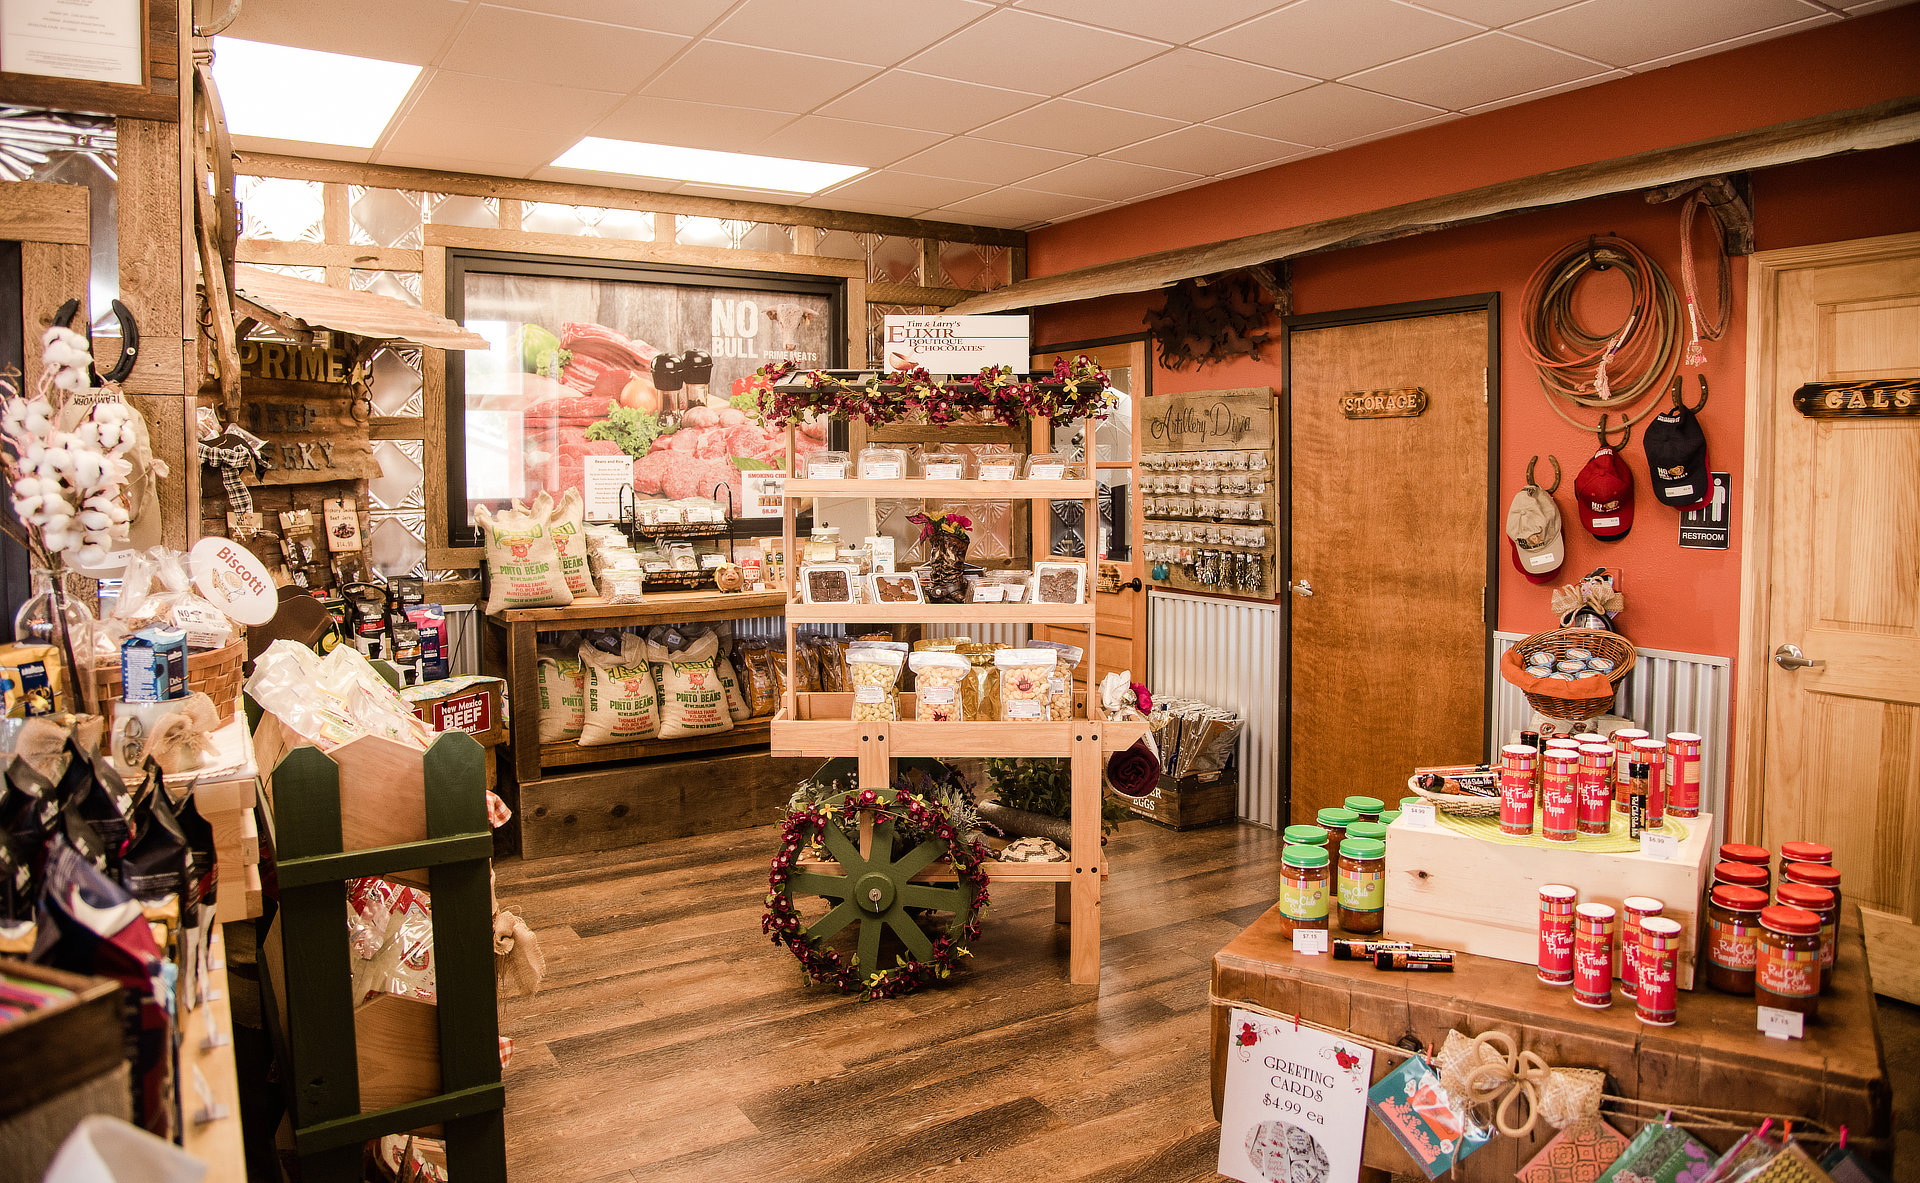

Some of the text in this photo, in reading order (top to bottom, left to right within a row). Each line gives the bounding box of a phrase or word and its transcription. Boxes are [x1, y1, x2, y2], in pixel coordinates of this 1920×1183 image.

[712, 299, 758, 338] NO
[933, 320, 961, 328] Larry's
[887, 325, 955, 343] ELIXIR
[712, 337, 758, 359] BULL
[909, 339, 963, 347] BOUTIQUE
[241, 342, 347, 384] PRIME
[764, 350, 817, 361] PRIME MEATS
[1345, 394, 1417, 411] STORAGE
[1825, 389, 1911, 408] GALS
[1682, 532, 1724, 541] RESTROOM
[500, 566, 522, 575] PINTO
[525, 563, 550, 575] BEANS
[563, 558, 583, 569] BEANS
[216, 546, 267, 597] Biscotti
[562, 697, 583, 707] PINTO
[590, 688, 598, 712] BEANS
[610, 700, 631, 710] PINTO
[635, 696, 653, 710] BEANS
[676, 692, 721, 702] PINTO BEANS
[441, 699, 482, 715] New Mexico
[443, 707, 482, 730] BEEF
[1502, 785, 1533, 799] Hot Fiesta
[1552, 792, 1572, 804] Fiesta
[1591, 785, 1610, 796] Fiesta
[1133, 798, 1155, 810] EGGS
[1506, 797, 1528, 812] Pepper
[1544, 801, 1565, 817] Pepper
[1582, 795, 1603, 810] Pepper
[1541, 930, 1556, 943] Hot
[1546, 942, 1570, 960] Pepper
[1718, 940, 1734, 951] Red
[1586, 951, 1608, 966] Fiesta
[1577, 961, 1600, 980] Pepper
[1646, 968, 1670, 983] Fiesta
[1767, 963, 1783, 978] Red
[1639, 977, 1661, 995] Pepper
[1791, 980, 1811, 991] Salsa
[1263, 1055, 1335, 1089] GREETING
[1270, 1076, 1324, 1103] CARDS
[1262, 1093, 1324, 1125] $4.99 ea
